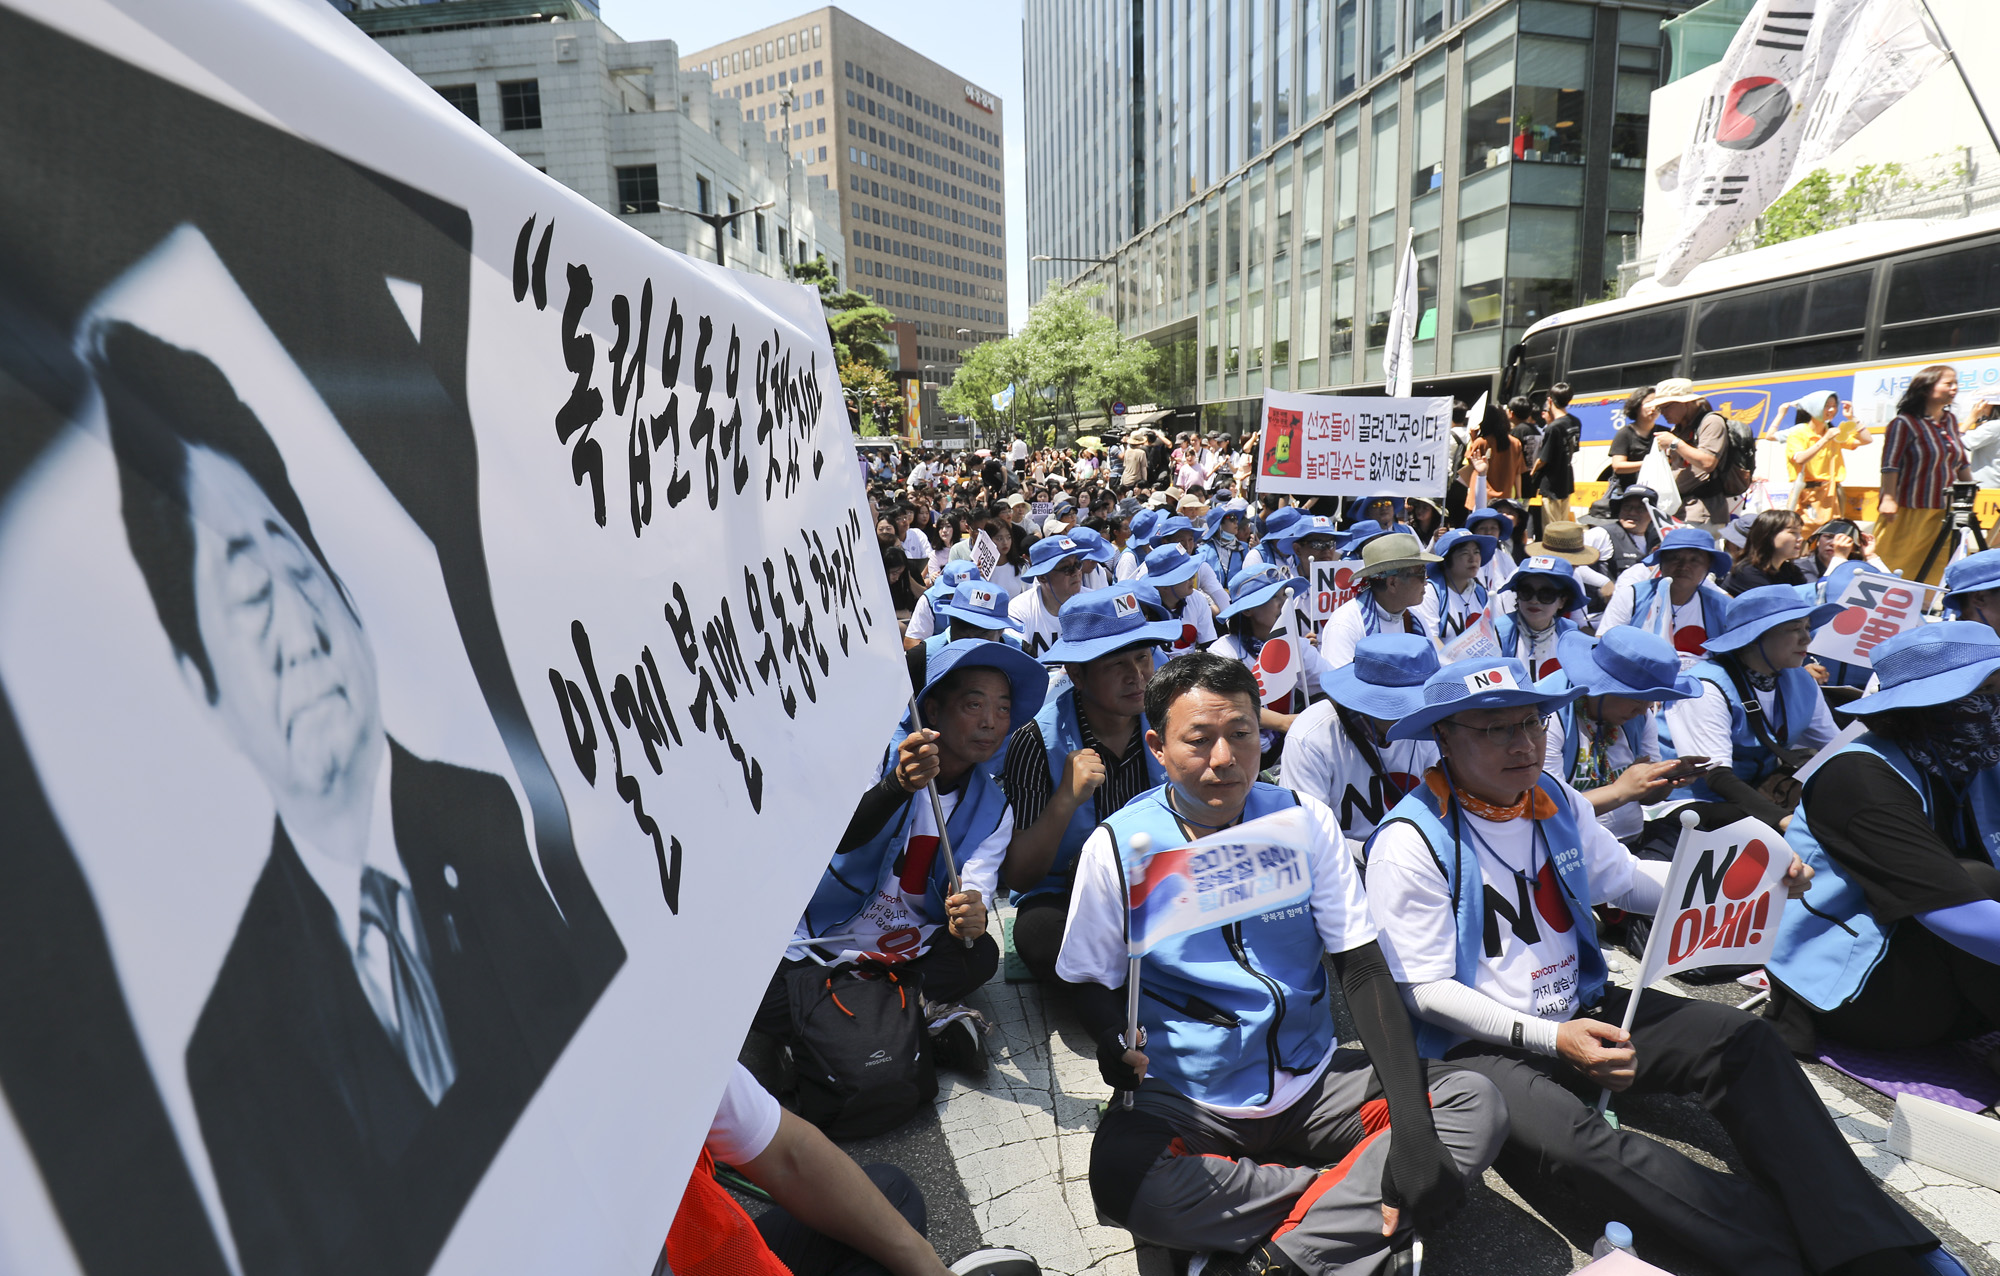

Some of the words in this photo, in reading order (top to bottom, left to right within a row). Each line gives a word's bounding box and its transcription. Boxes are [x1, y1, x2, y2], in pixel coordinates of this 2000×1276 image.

[1307, 410, 1355, 441] 선조들이
[1359, 413, 1442, 443] 끌려간곳이다.
[1306, 450, 1366, 480] 놀러갈수는
[1369, 451, 1436, 482] 없지않은가
[1318, 567, 1355, 592] NO
[975, 591, 991, 601] NO
[1114, 593, 1137, 613] NO
[1474, 670, 1503, 689] NO
[549, 619, 683, 916] 일제
[1555, 848, 1579, 866] 2019
[1680, 838, 1769, 910] NO
[1261, 910, 1285, 923] 광복절
[1286, 906, 1303, 918] 함께
[1667, 891, 1770, 965] 아베!
[1530, 963, 1560, 981] BOYCOT
[864, 1056, 893, 1067] PROSPECS
